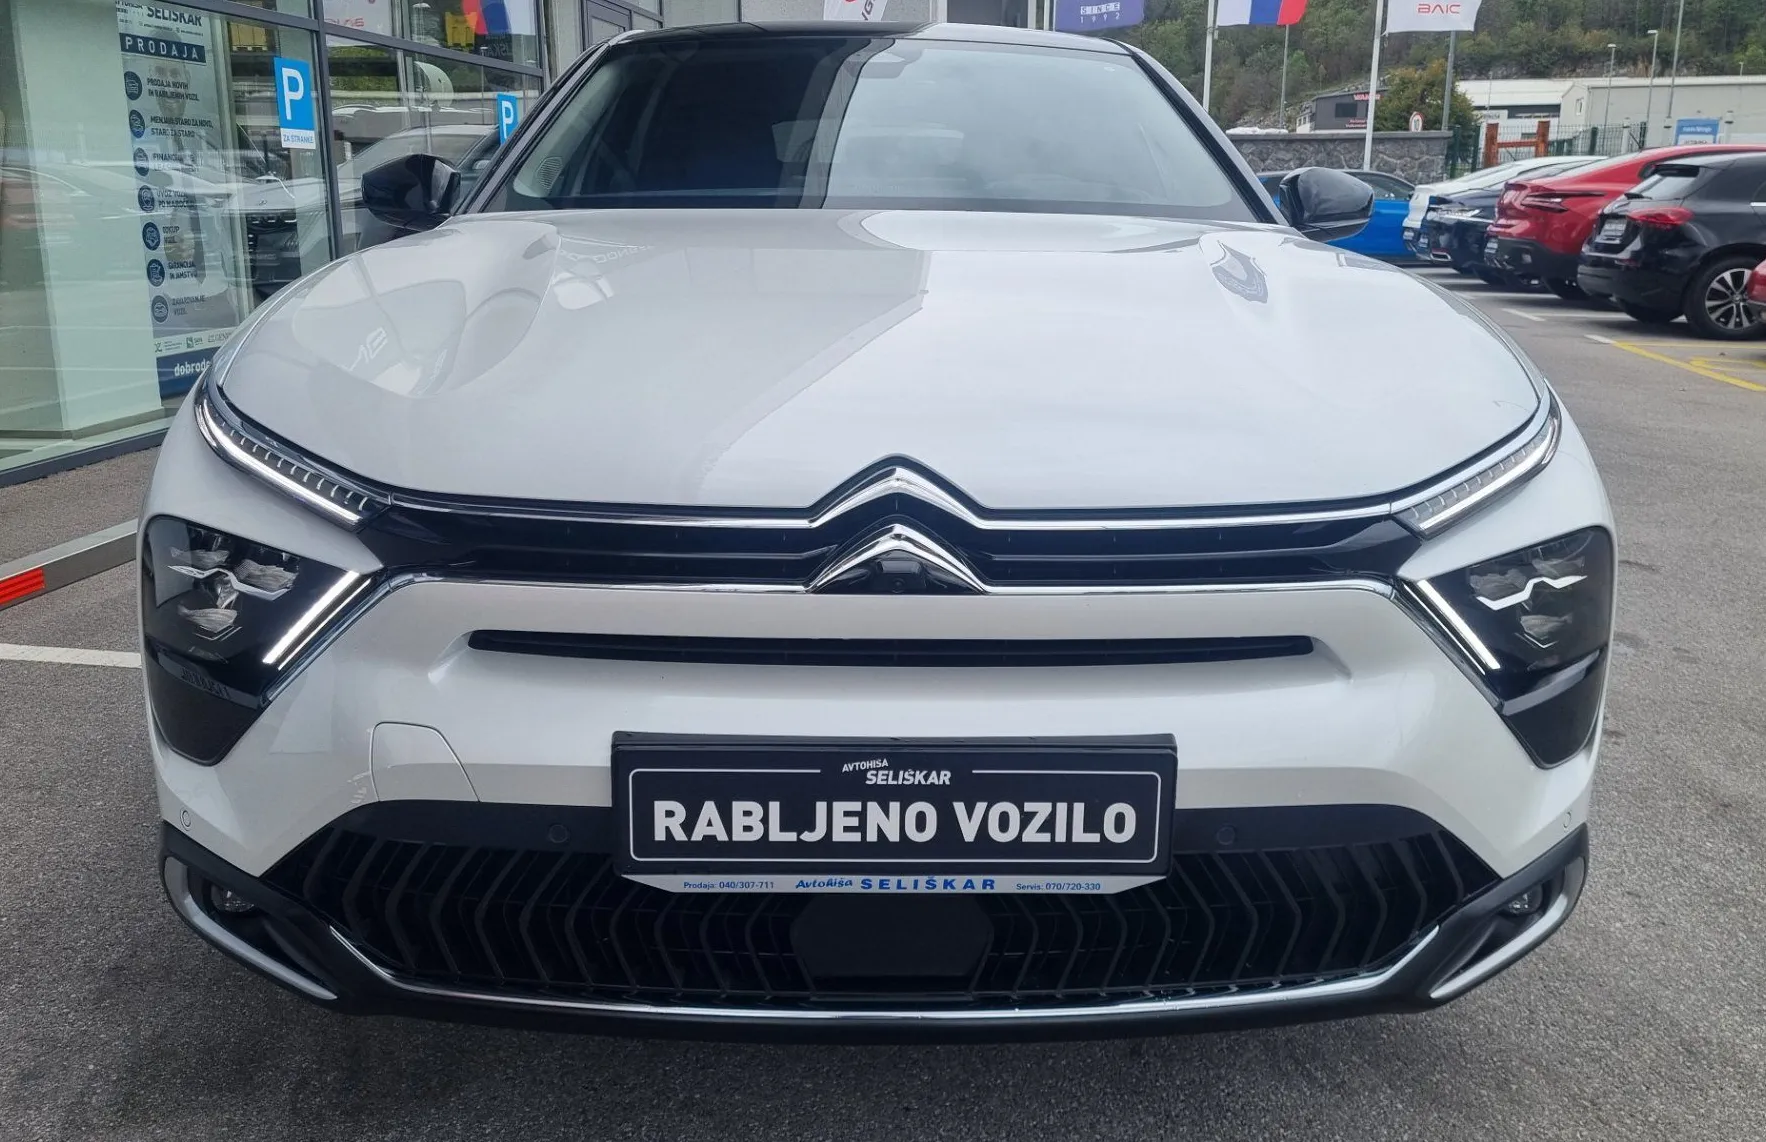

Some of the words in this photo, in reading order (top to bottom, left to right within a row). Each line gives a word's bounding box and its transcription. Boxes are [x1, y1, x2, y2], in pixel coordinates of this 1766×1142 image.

[1418, 3, 1461, 14] BAIC
[125, 36, 199, 60] PRODAJA
[281, 66, 304, 121] P
[501, 100, 514, 140] P
[865, 768, 951, 786] SELIŠKAR
[653, 800, 938, 843] RABLJENO
[952, 801, 1137, 844] VOZILO
[683, 881, 717, 890] Prodaja:
[719, 880, 774, 890] 040/307-711
[795, 877, 853, 889] Avtohiša
[860, 876, 996, 891] SELIŠKAR
[1016, 882, 1044, 891] Servis:
[1045, 882, 1101, 892] 070/720-330
